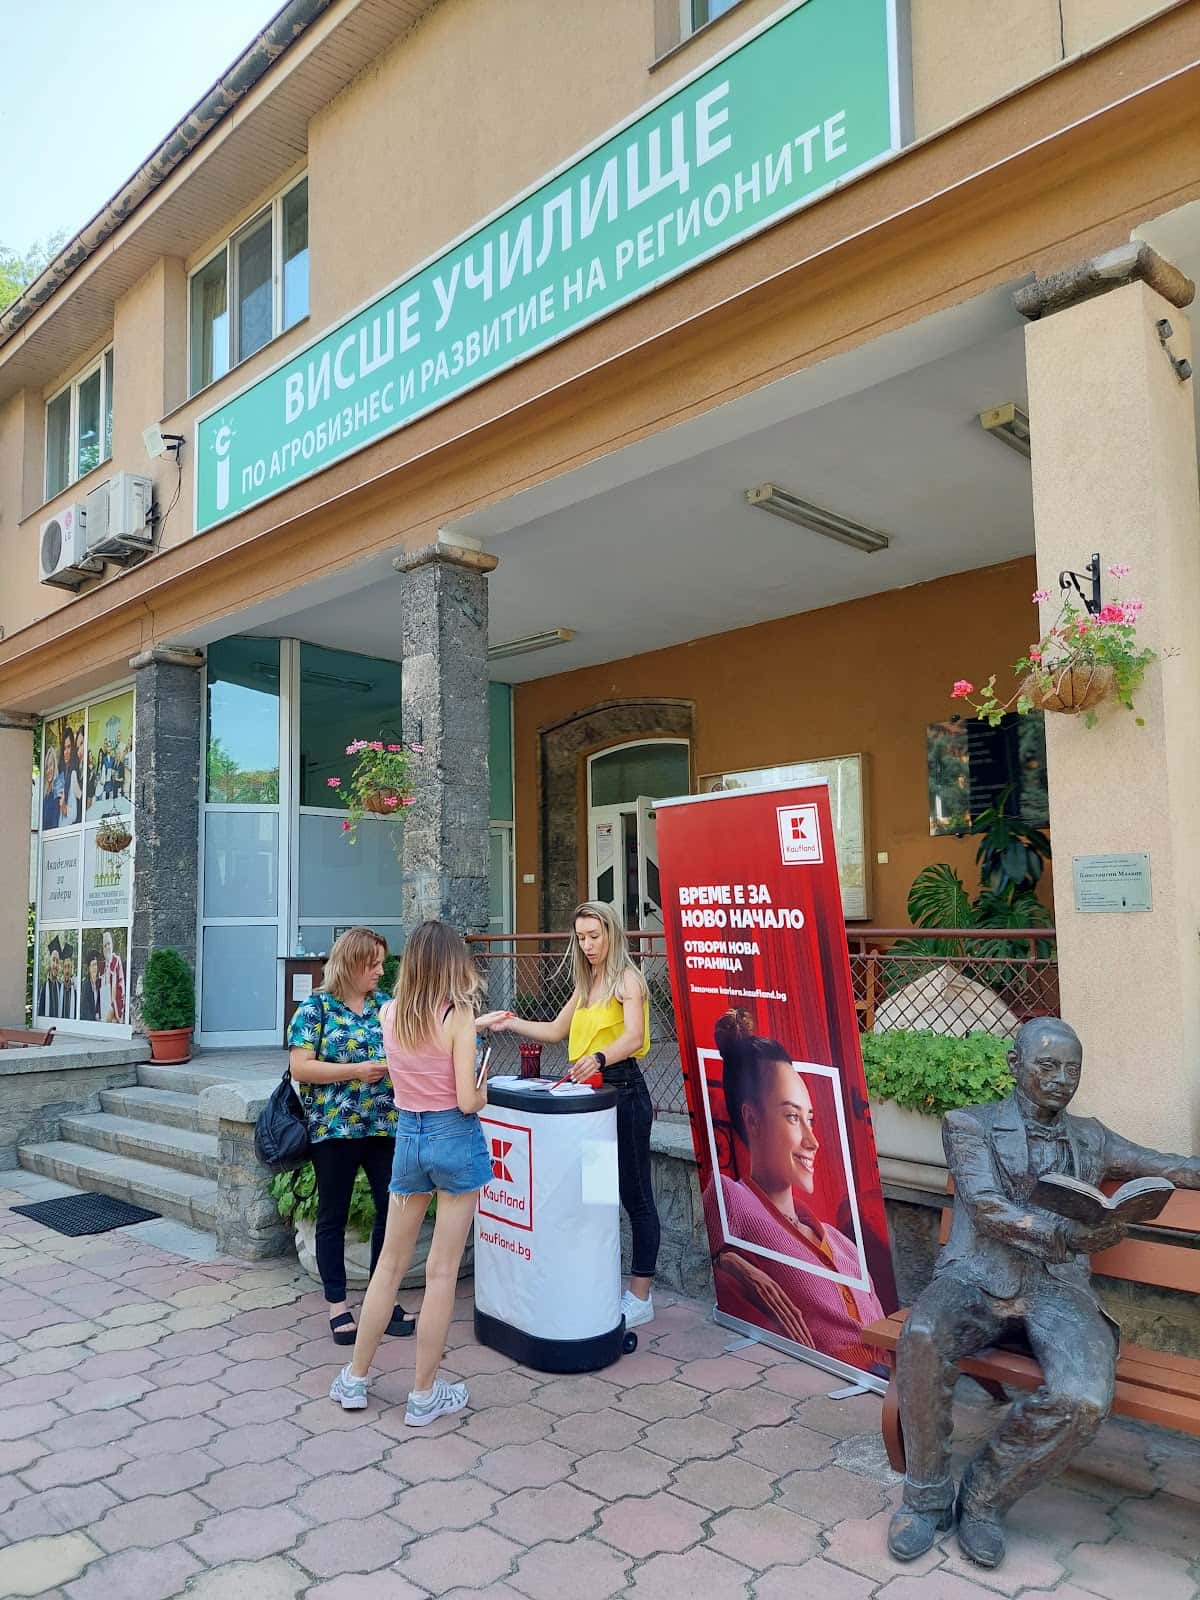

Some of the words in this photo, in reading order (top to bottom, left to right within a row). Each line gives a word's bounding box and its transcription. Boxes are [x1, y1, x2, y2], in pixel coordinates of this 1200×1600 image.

[285, 290, 421, 425] ВИСШЕ
[432, 79, 732, 332] УЧИЛИЩЕ
[241, 459, 266, 495] ПО
[269, 381, 394, 479] АГРОБИЗНЕС
[400, 368, 415, 405] И
[420, 284, 556, 393] РАЗВИТИЕ
[563, 257, 607, 312] НА
[615, 109, 848, 281] РЕГИОНИТЕ
[786, 844, 816, 854] Kaufland
[678, 885, 731, 905] ВРЕМЕ
[734, 885, 744, 905] Е
[748, 884, 771, 904] ЗА
[681, 909, 727, 928] НОВО
[730, 909, 805, 929] НАЧАЛО
[684, 940, 727, 954] ОТВОРИ
[728, 941, 760, 955] НОВА
[686, 956, 743, 972] СТРАНИЦА
[483, 1185, 526, 1210] Kaufland
